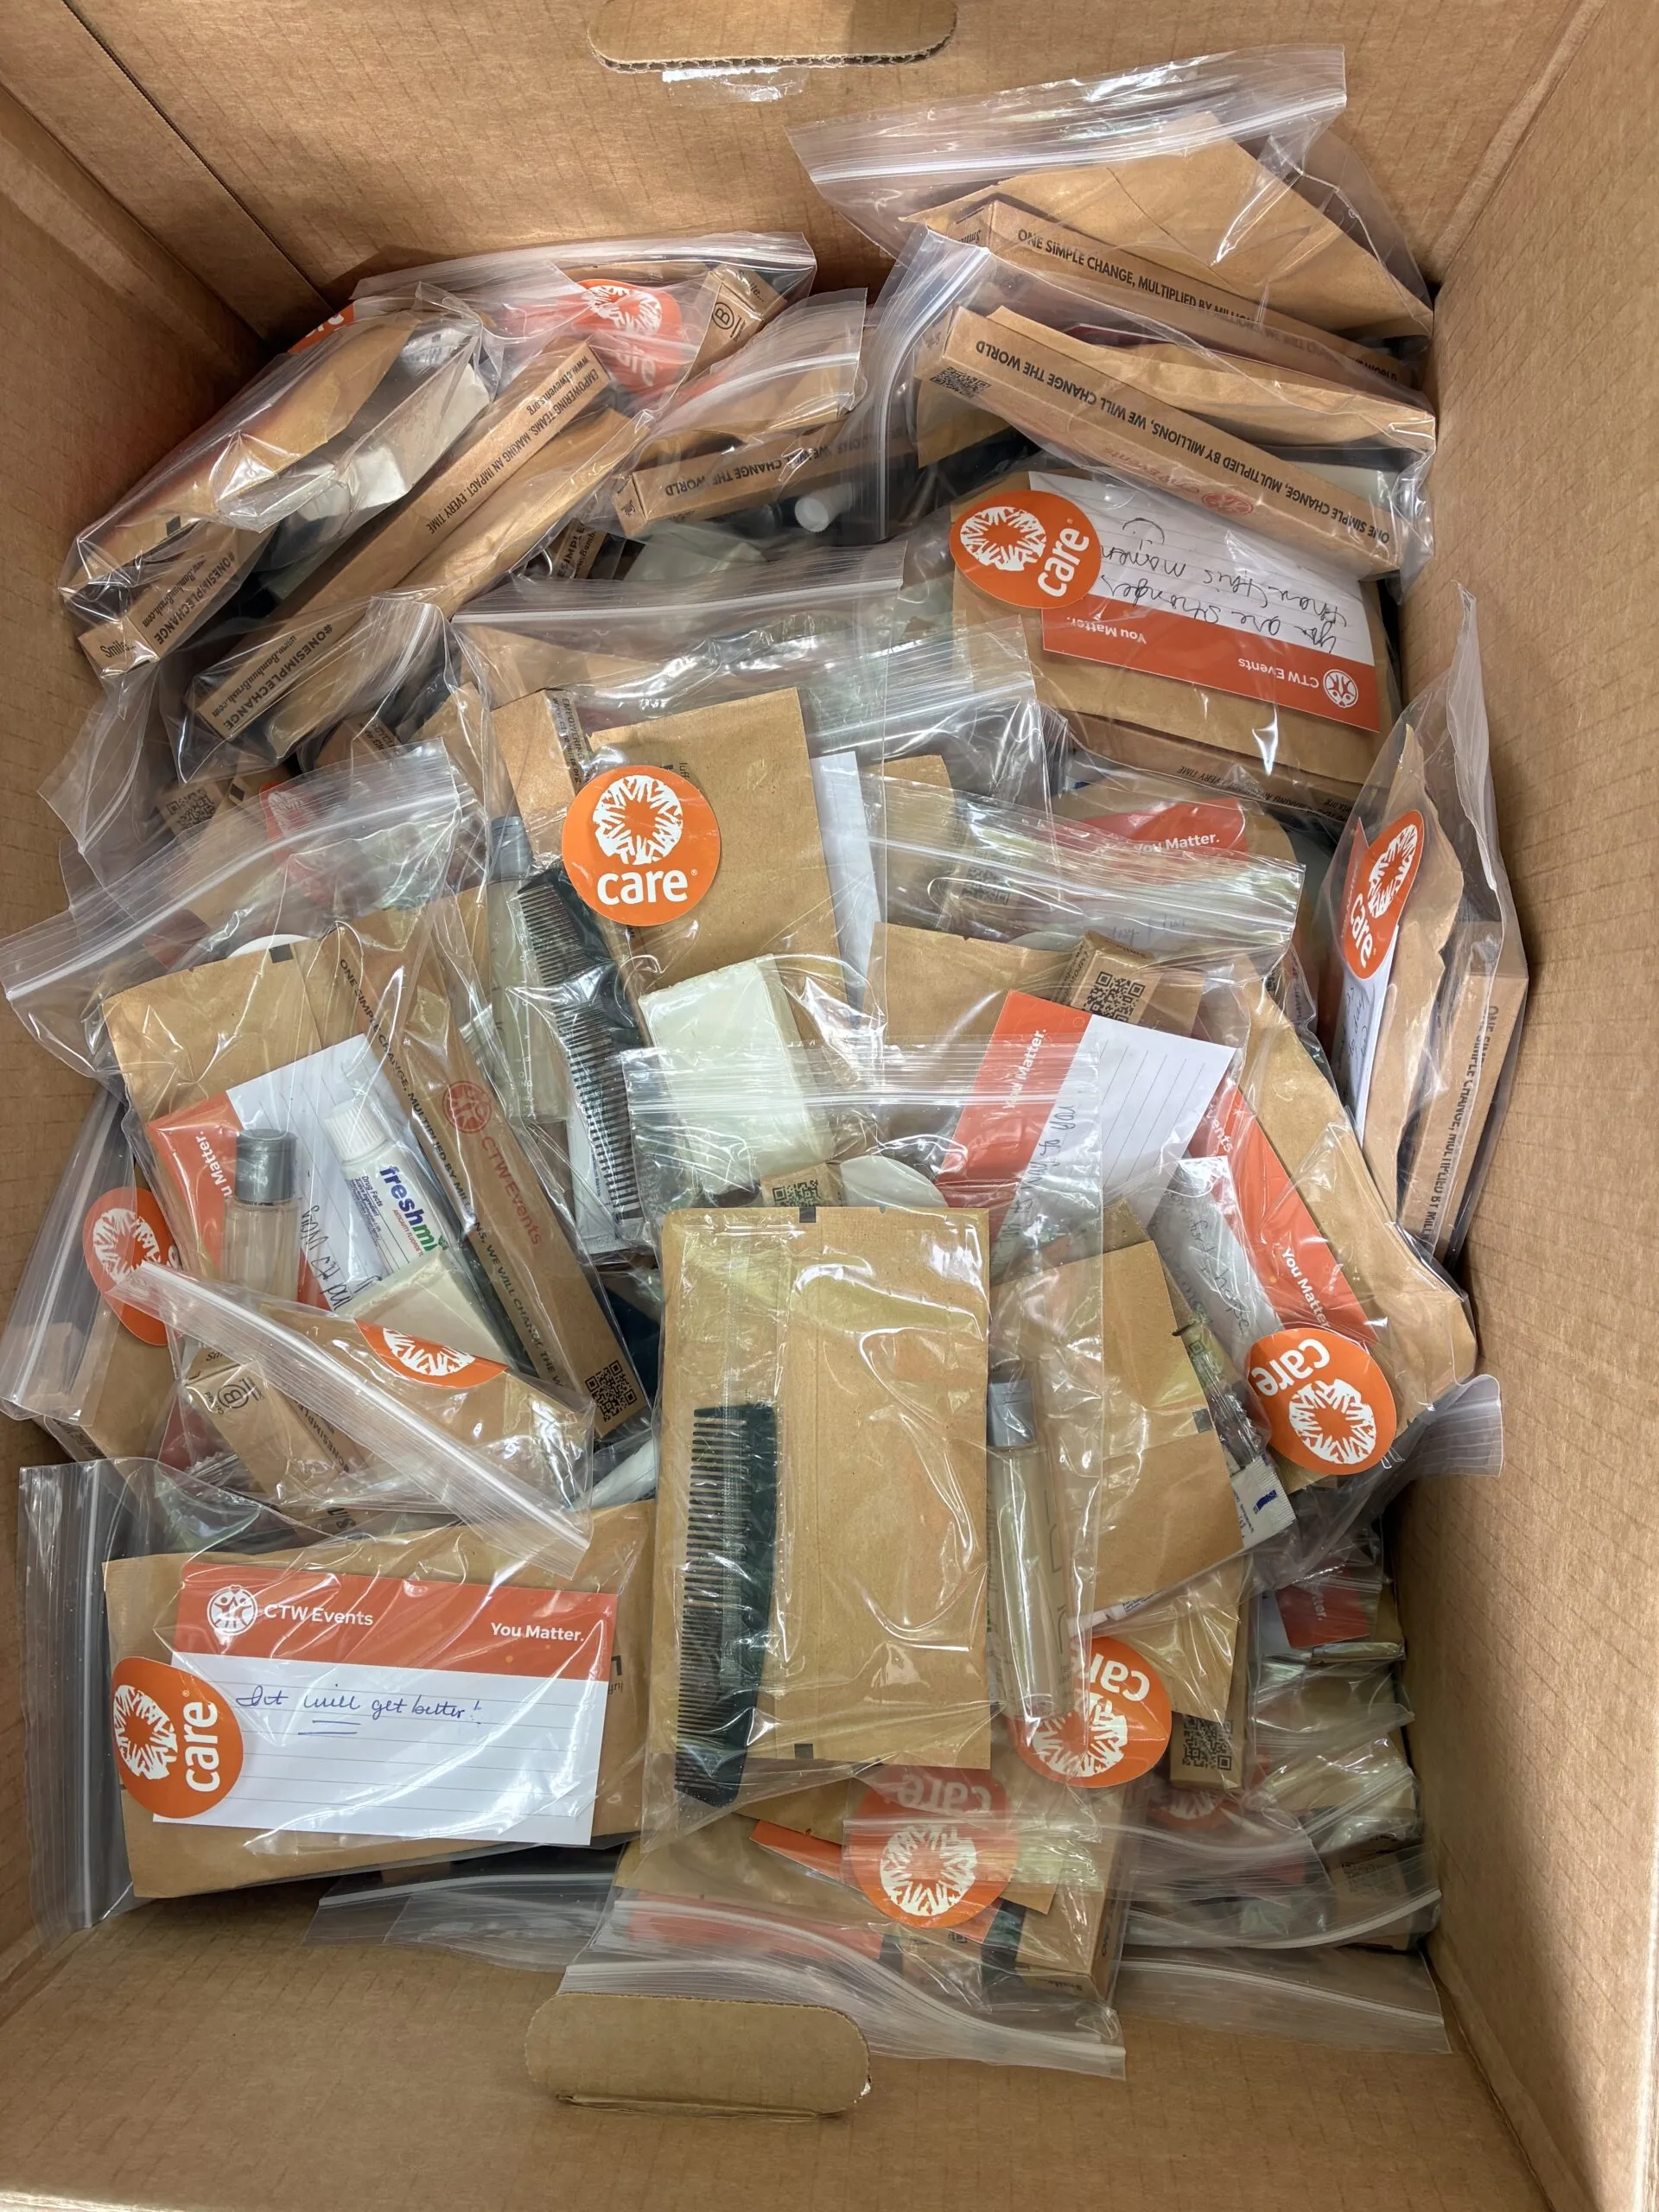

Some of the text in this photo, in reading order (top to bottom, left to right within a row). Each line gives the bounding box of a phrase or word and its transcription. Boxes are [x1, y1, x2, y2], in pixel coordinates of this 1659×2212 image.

[1015, 228, 1045, 249] ONE
[1044, 239, 1086, 265] SIMPLE
[1084, 255, 1139, 288] CHANGE,
[1135, 275, 1199, 308] MULTIPLIED
[973, 338, 1024, 371] WORLD
[1020, 361, 1048, 383] THE
[1045, 372, 1098, 406] CHANGE
[1096, 397, 1128, 420] WILL
[1125, 410, 1149, 430] WE
[424, 365, 601, 535] EMPOWERING TEAMS. MAKING AN IMPACT. EVERY TIME
[1146, 417, 1207, 457] MILLIONS,
[733, 454, 782, 480] CHANGE
[1204, 447, 1222, 464] BY
[664, 474, 708, 498] WORLD
[1220, 455, 1282, 493] MULTIPLIED
[1280, 482, 1332, 516] CHANGE,
[1328, 507, 1368, 533] SIMPLE
[1365, 524, 1389, 543] ONE
[1038, 525, 1090, 597] care
[1096, 543, 1186, 579] momen
[1064, 614, 1148, 645] You Matter.
[219, 621, 336, 731] #ONESIMPLECHANGE
[1236, 656, 1321, 689] CTW Events
[1163, 829, 1220, 853] Matter.
[597, 870, 688, 906] care
[1348, 893, 1373, 969] care
[1012, 1025, 1049, 1083] Matter.
[1203, 1106, 1236, 1154] vents
[195, 1132, 225, 1182] Matter.
[335, 957, 359, 988] ONE
[372, 1032, 414, 1093] CHANGE,
[442, 1161, 457, 1180] BY
[483, 1243, 501, 1266] WE
[494, 1266, 517, 1296] WILL
[538, 1350, 556, 1375] THE
[359, 1173, 385, 1208] Drug Facts
[477, 1133, 548, 1248] CTW Events
[1278, 1244, 1305, 1279] You
[1252, 1338, 1330, 1396] care
[263, 1603, 585, 1643] CTW Events You Matter.
[302, 1684, 360, 1710] will
[371, 1699, 412, 1720] get
[185, 1701, 219, 1792] care
